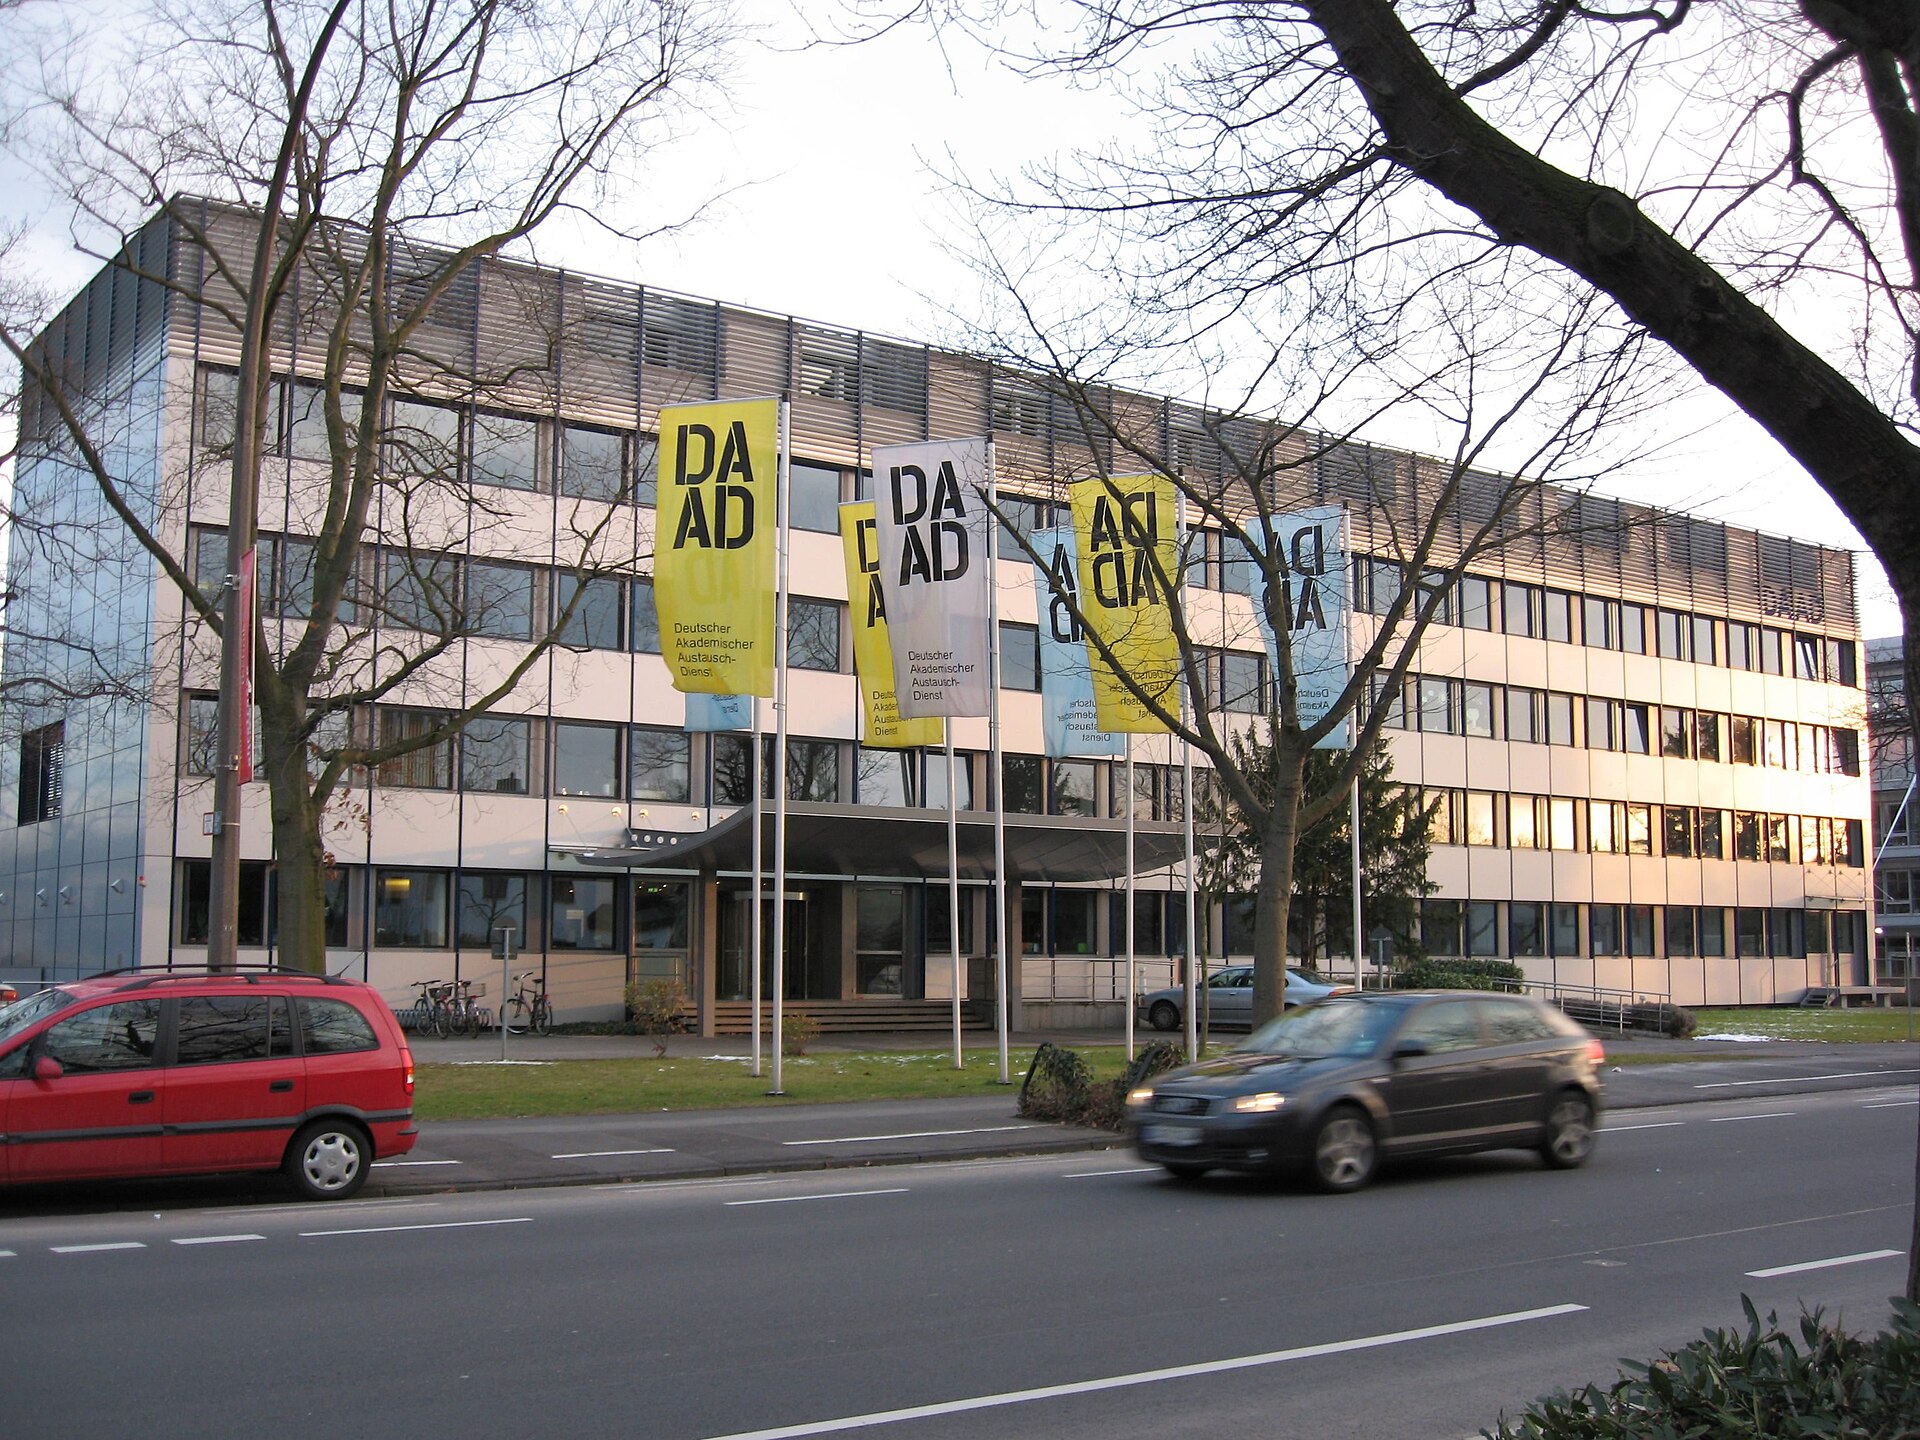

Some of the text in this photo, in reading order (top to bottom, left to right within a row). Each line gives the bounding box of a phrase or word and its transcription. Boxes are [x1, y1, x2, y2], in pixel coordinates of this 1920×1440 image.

[675, 421, 754, 485] DA
[890, 461, 967, 525] DA
[672, 485, 755, 549] AD
[899, 521, 969, 586] AD
[674, 622, 732, 634] Deutscher
[675, 637, 754, 650] Akademischer
[677, 652, 736, 664] Austausch-
[908, 651, 953, 661] Deutscher
[910, 663, 975, 674] Akademischer
[912, 677, 960, 687] Austausch-
[913, 690, 943, 701] Dienst
[874, 726, 898, 736] Dienst
